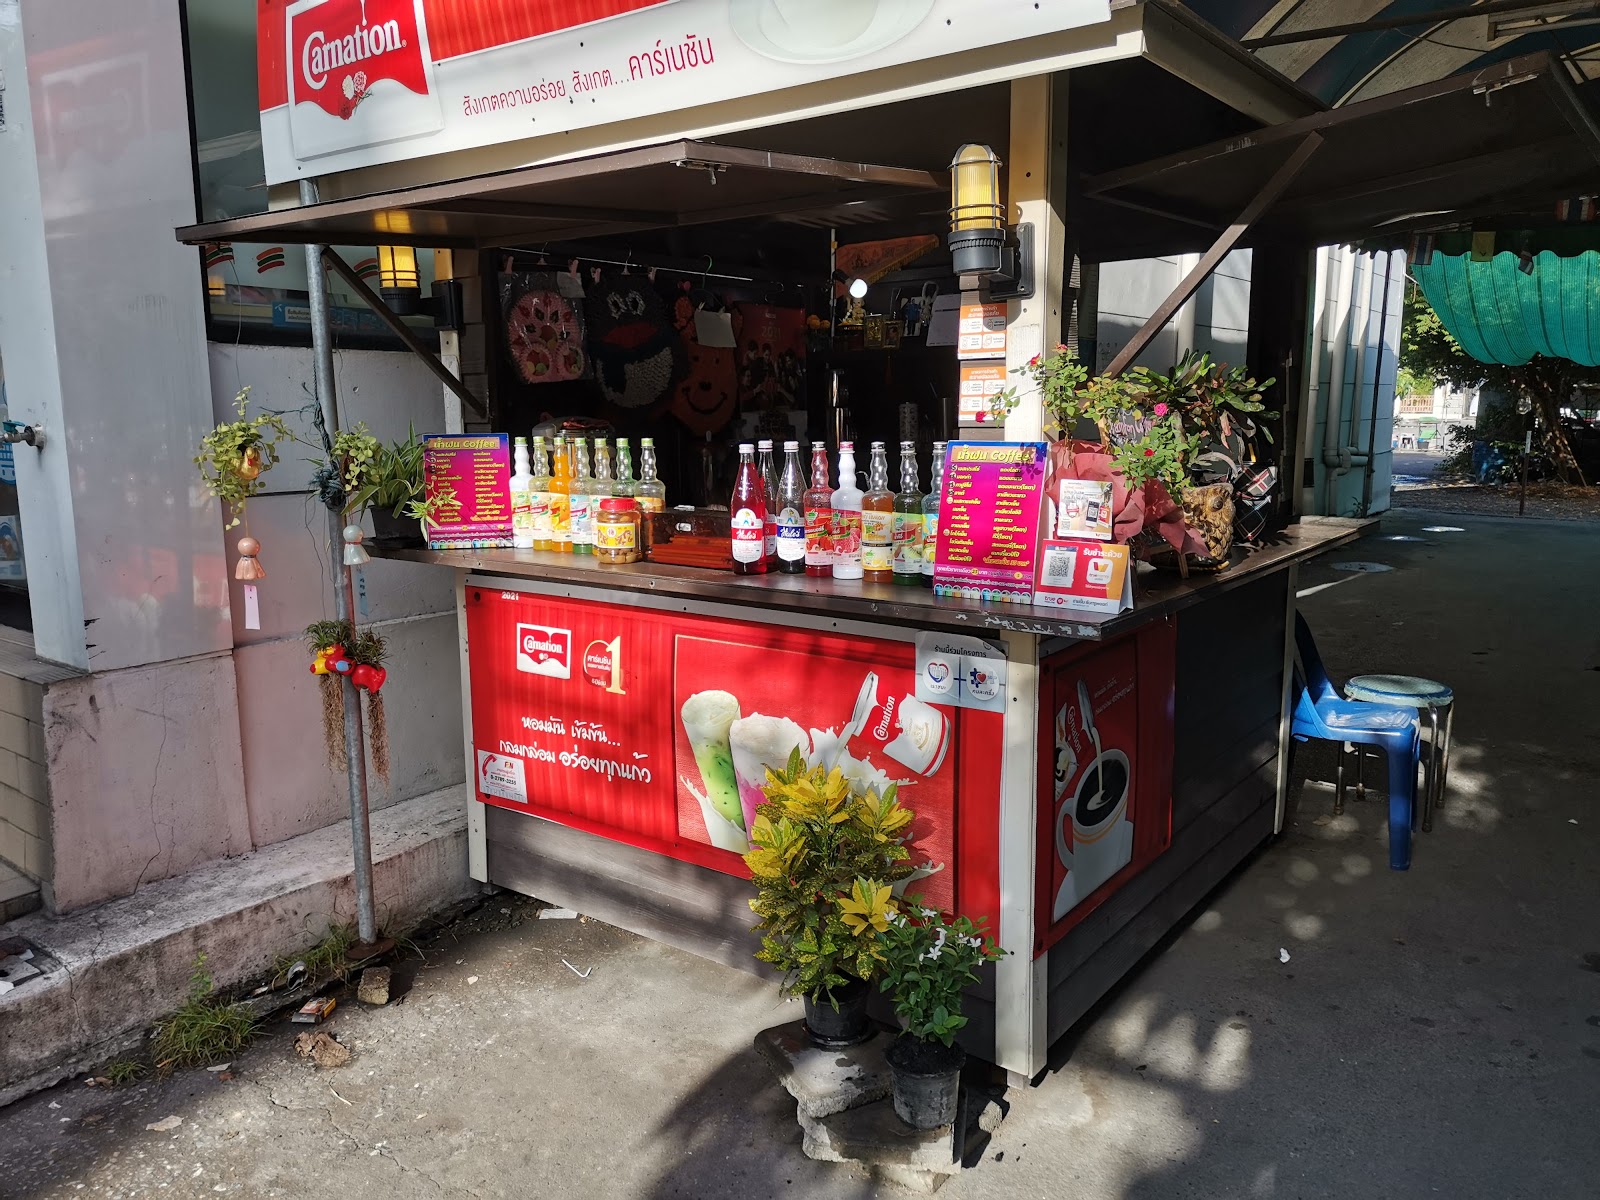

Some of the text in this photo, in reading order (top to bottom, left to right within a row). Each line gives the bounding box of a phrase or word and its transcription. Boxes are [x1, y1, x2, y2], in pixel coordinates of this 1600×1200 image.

[302, 19, 401, 90] Carnation
[463, 439, 496, 450] Coffee
[990, 450, 1030, 464] Coffee
[501, 591, 519, 600] 2021
[523, 635, 563, 653] Carnation
[934, 644, 987, 657] ร้านนี้ร่วมโครงการ
[521, 715, 566, 735] หอมมัน
[873, 695, 896, 741] Carnation
[1067, 705, 1082, 753] Carnation
[499, 739, 652, 784] กลมกล่อม อร่อยทุกแก้ว
